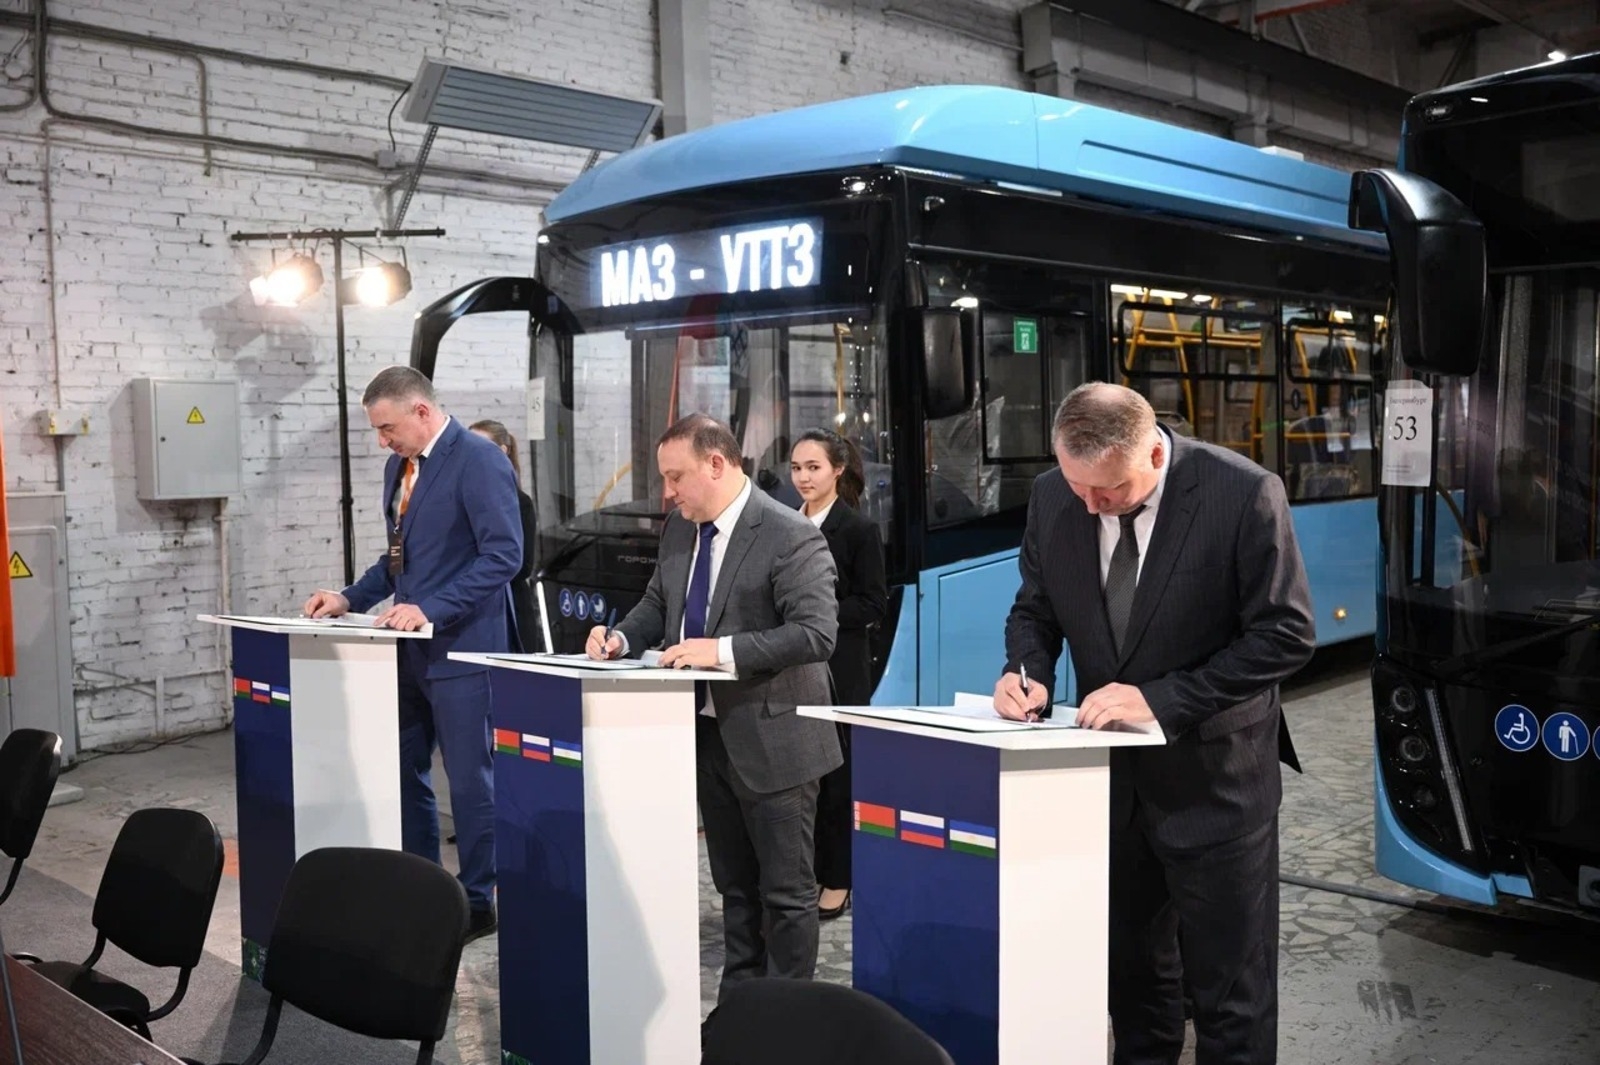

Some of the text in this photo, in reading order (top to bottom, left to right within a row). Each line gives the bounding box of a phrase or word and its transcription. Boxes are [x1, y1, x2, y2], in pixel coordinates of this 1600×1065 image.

[601, 243, 676, 307] МАЗ
[690, 268, 705, 280] -
[1393, 415, 1418, 441] 53
